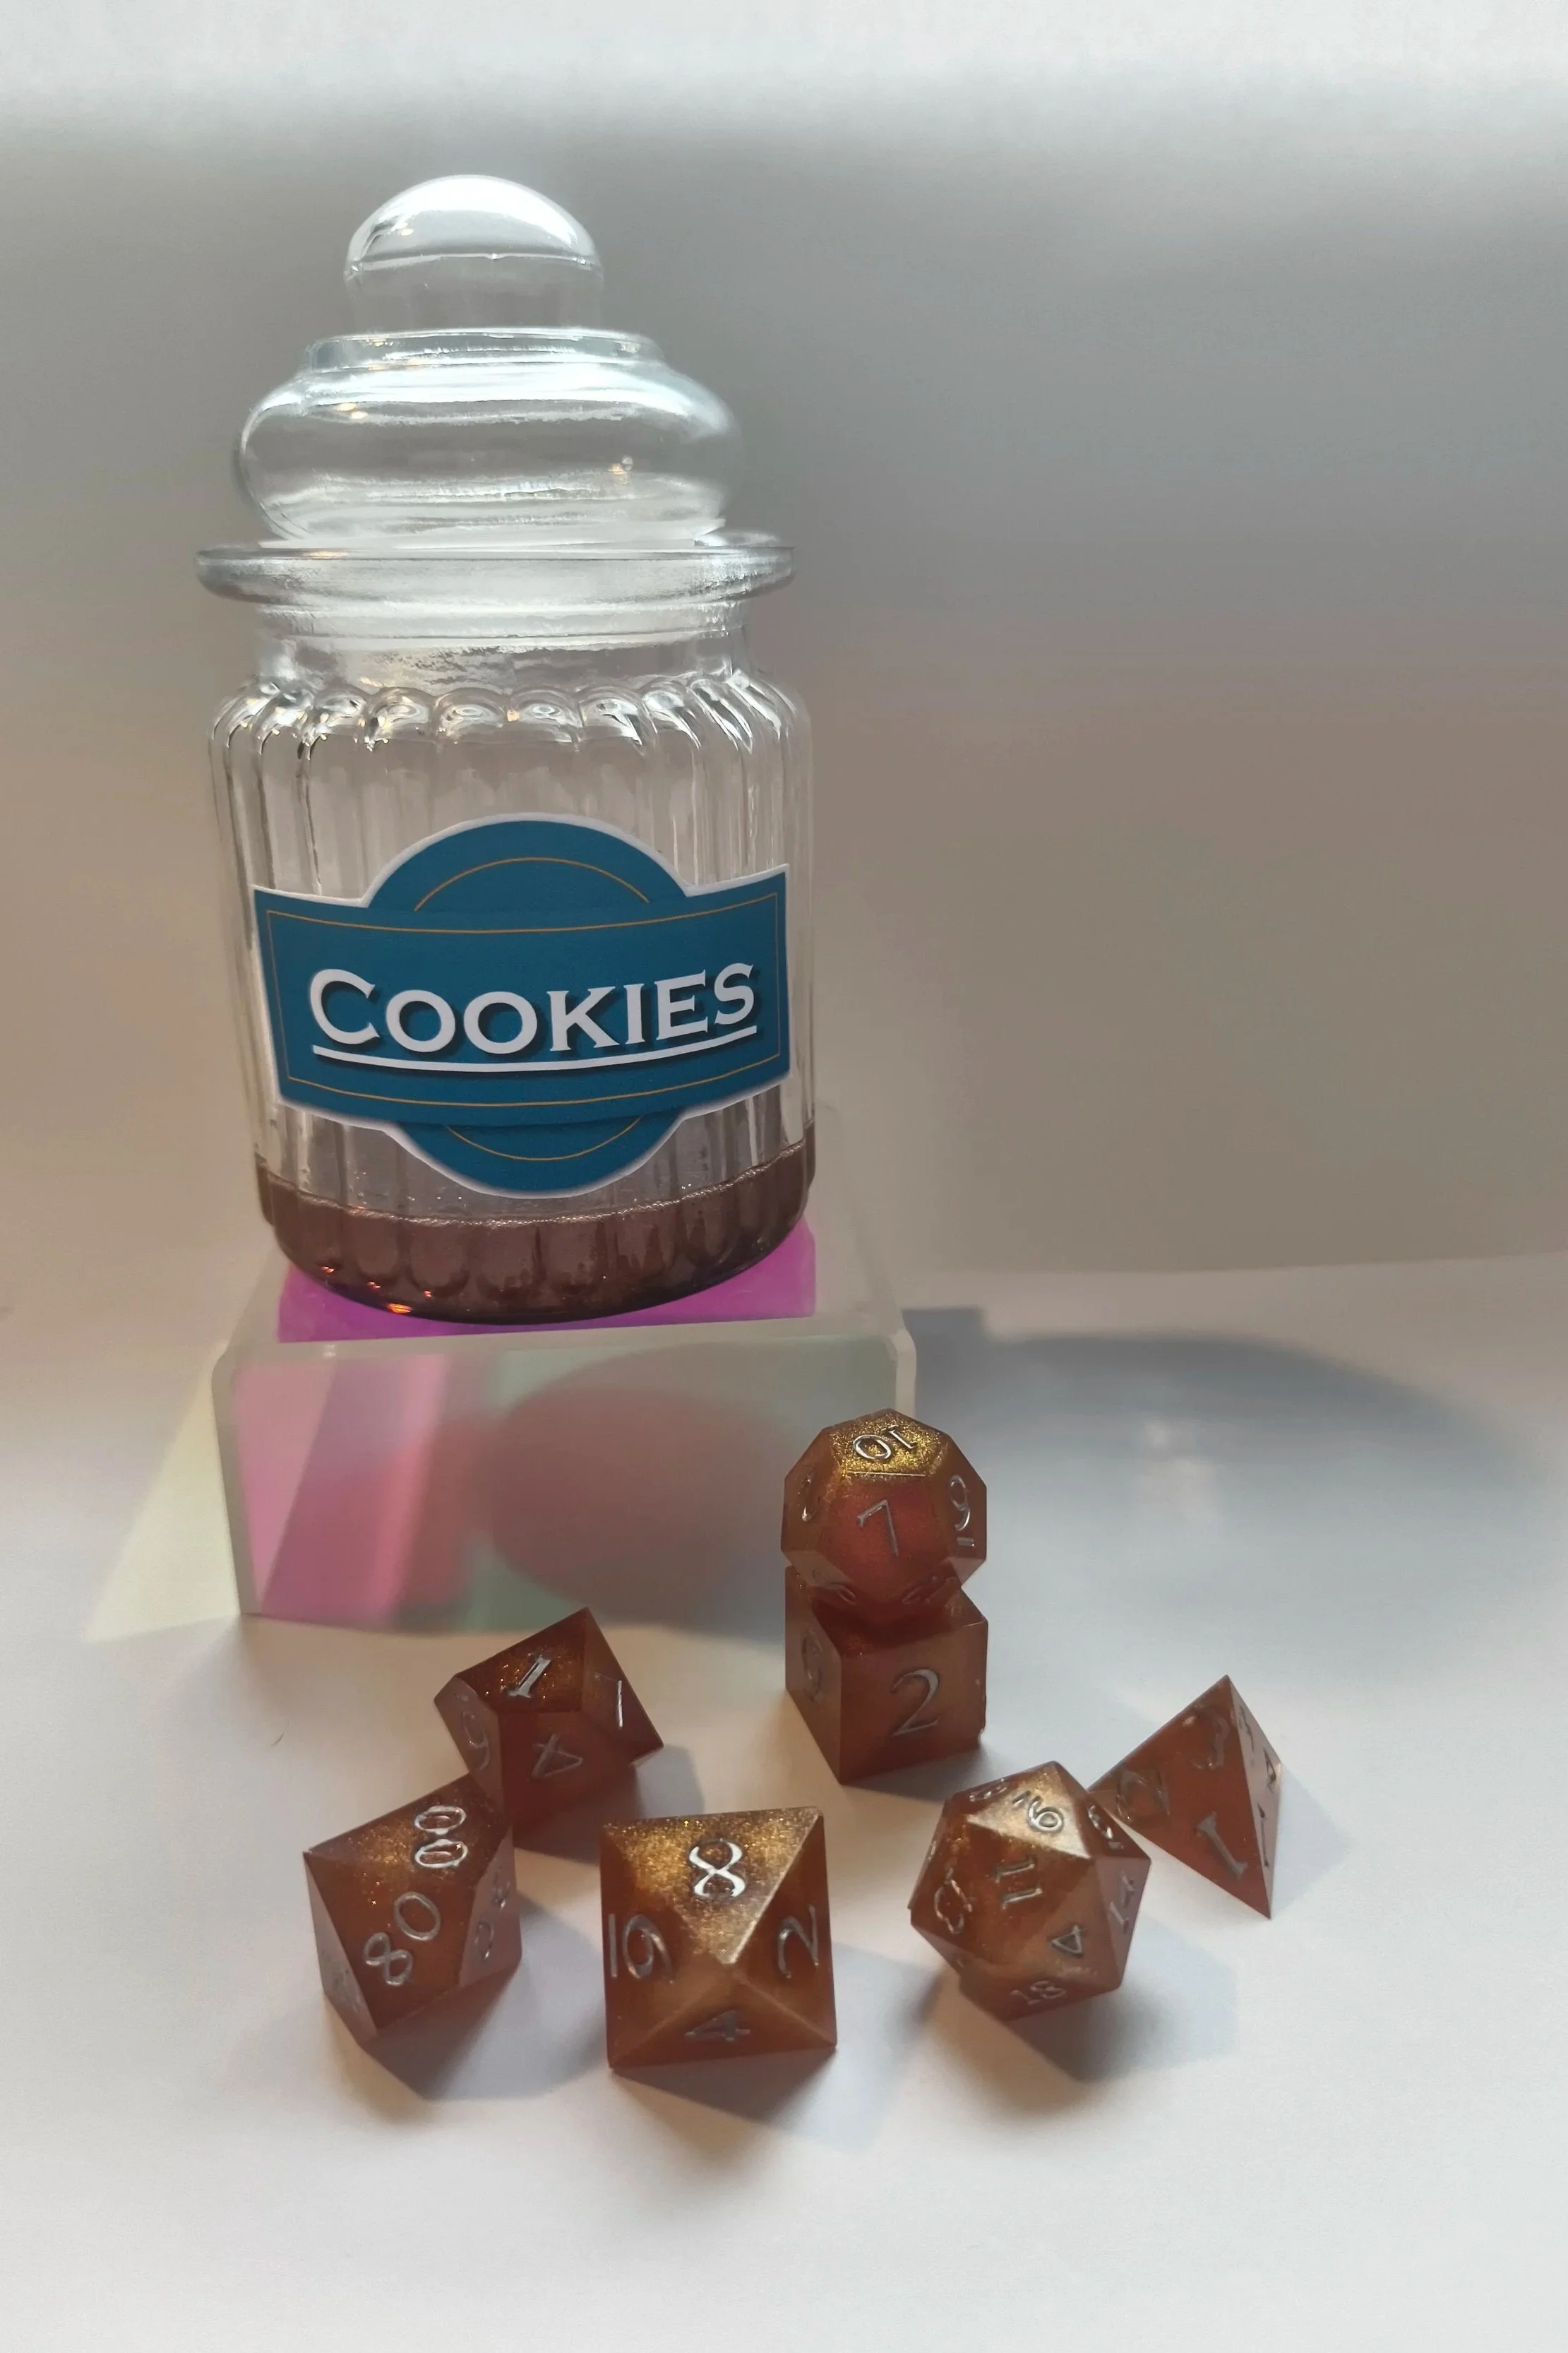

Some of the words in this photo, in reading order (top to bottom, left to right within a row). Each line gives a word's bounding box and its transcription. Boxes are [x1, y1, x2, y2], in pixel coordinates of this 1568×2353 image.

[309, 963, 755, 1054] COOKIES
[856, 1499, 900, 1558] 7
[507, 1654, 552, 1699] 1
[890, 1668, 940, 1738] 2
[688, 1837, 747, 1899] 8
[1192, 1810, 1249, 1880] 1
[362, 1890, 442, 1986] 80
[777, 1904, 820, 1979] 2
[1049, 1922, 1088, 1959] 4
[683, 2008, 752, 2043] 4
